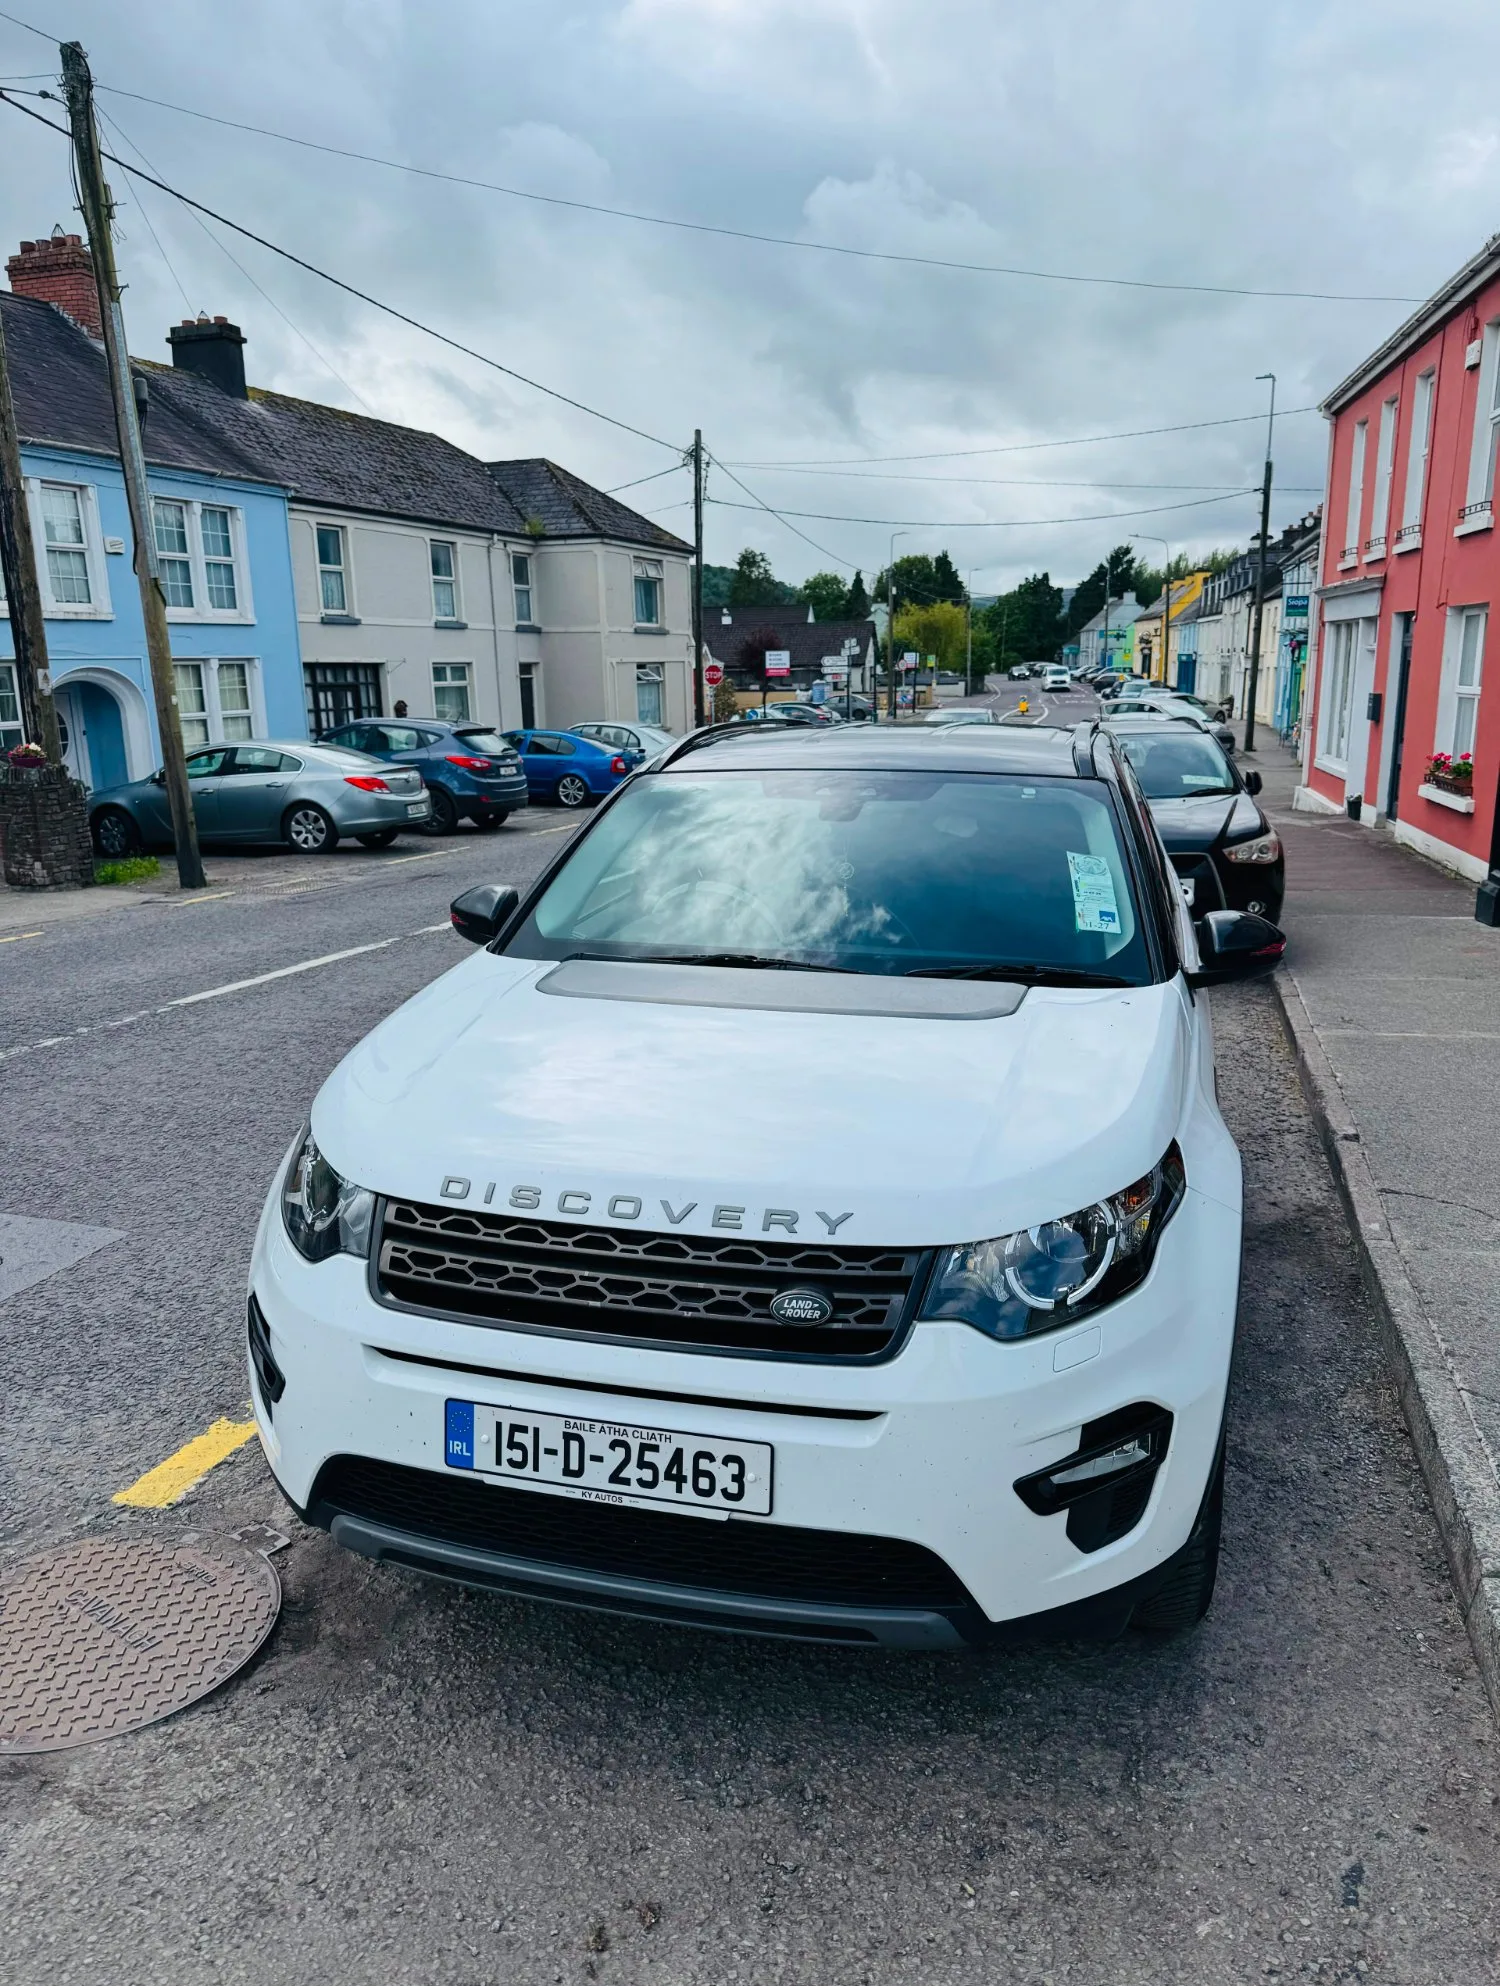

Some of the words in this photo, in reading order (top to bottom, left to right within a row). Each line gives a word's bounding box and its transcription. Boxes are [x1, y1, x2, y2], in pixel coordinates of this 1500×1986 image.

[705, 671, 722, 679] STOP
[439, 1175, 854, 1236] DISCOVERY
[783, 1299, 813, 1309] LAND
[785, 1308, 821, 1319] ROVER
[564, 1420, 596, 1433] BAILE
[598, 1423, 629, 1438] ÁTHA
[631, 1429, 672, 1444] CLIATH
[449, 1439, 471, 1457] IRL
[495, 1420, 746, 1502] 151-D-25463
[581, 1490, 593, 1499] KY
[594, 1492, 624, 1504] AUTOS
[65, 1589, 163, 1653] CAVANAGH
